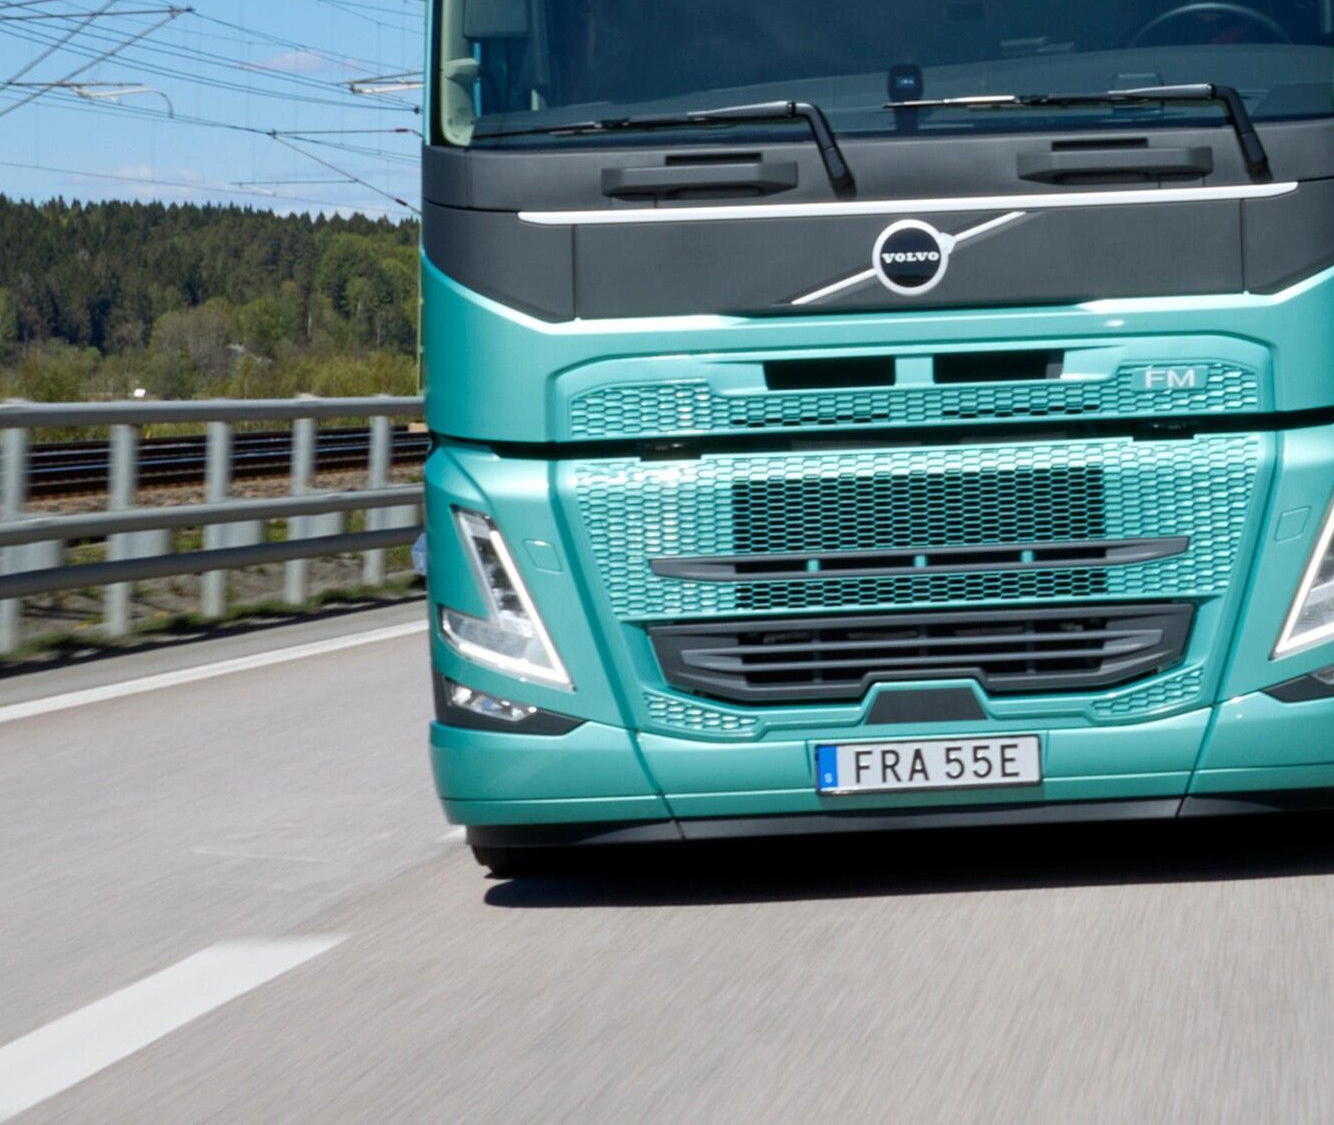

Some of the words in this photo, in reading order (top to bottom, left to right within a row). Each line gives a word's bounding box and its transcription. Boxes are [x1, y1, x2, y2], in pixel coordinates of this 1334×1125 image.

[881, 250, 940, 264] VOLVO
[1144, 368, 1195, 390] FM
[854, 747, 930, 784] FRA
[945, 743, 1020, 780] 55E
